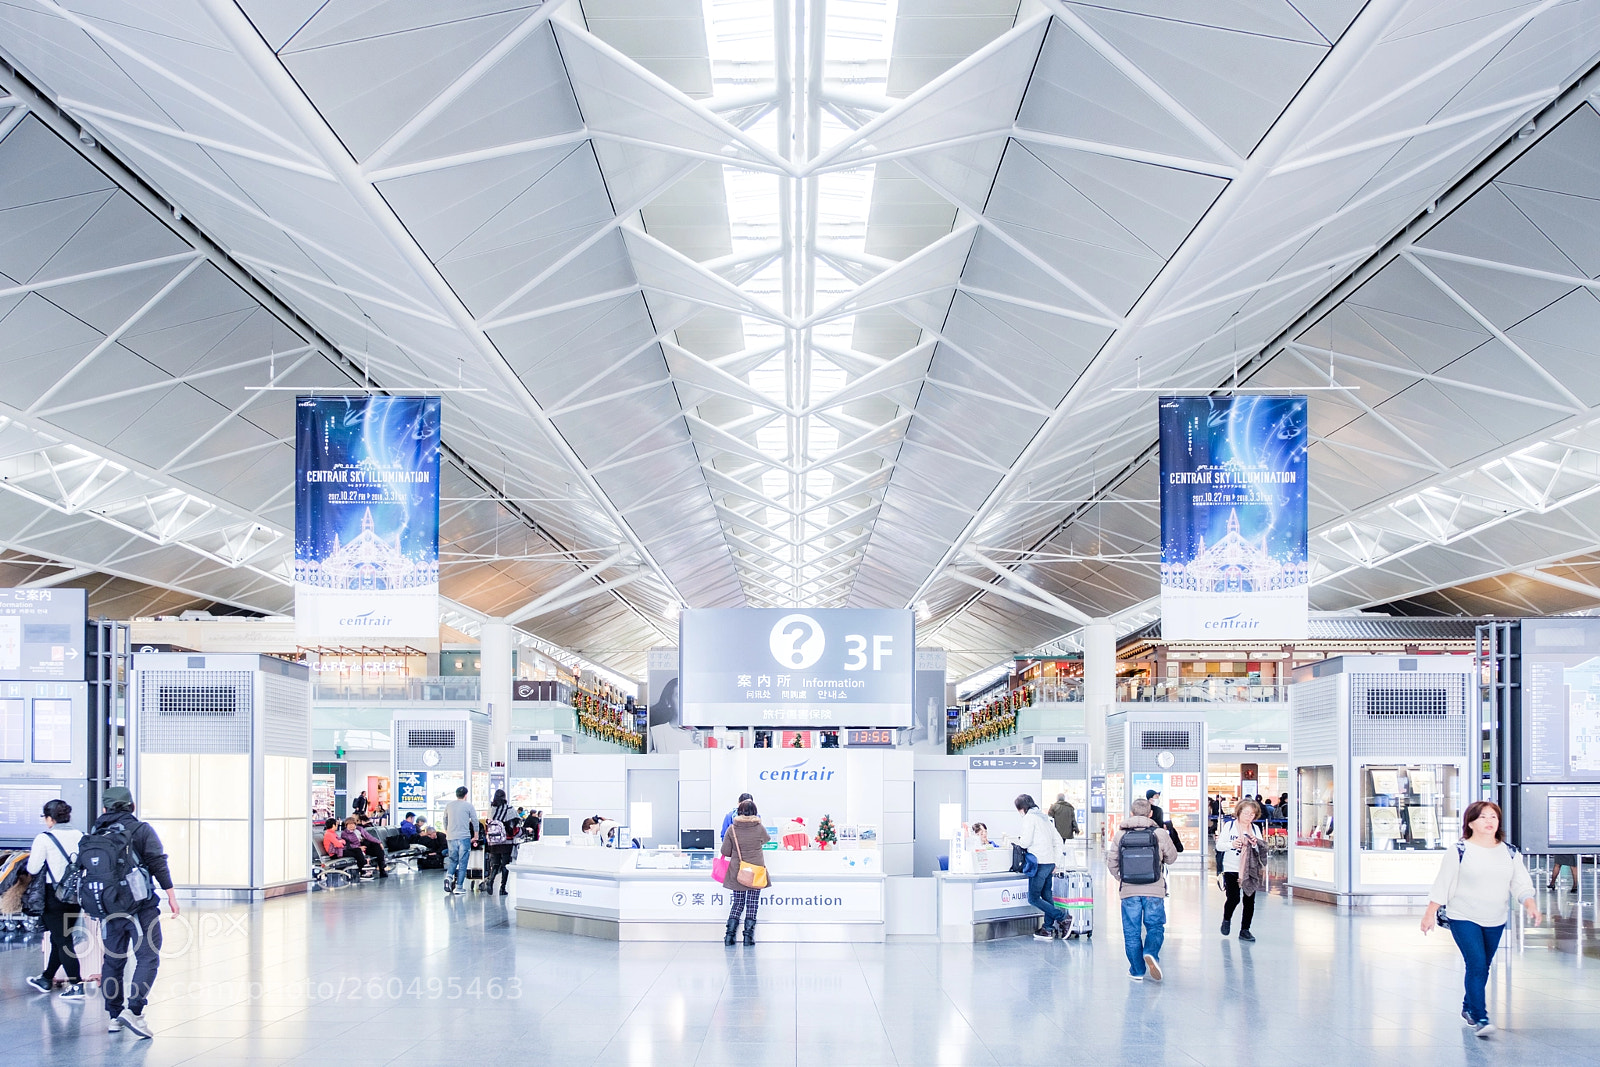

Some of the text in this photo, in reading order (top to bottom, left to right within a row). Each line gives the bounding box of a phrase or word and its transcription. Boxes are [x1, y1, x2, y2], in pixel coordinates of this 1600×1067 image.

[307, 471, 430, 483] CENTRAIR SKY ILLUMINATION
[1169, 471, 1297, 484] CENTRAIR SKY ILLUMINATION
[14, 589, 52, 601] ご案内
[339, 609, 393, 626] centrair
[1204, 613, 1260, 629] centrair
[843, 634, 893, 671] 3F
[737, 674, 865, 688] 案内所 Information
[817, 690, 848, 700] 안내소
[853, 730, 891, 742] 13:56
[759, 760, 835, 781] centrair
[406, 773, 420, 786] 本
[760, 894, 842, 906] nformation
